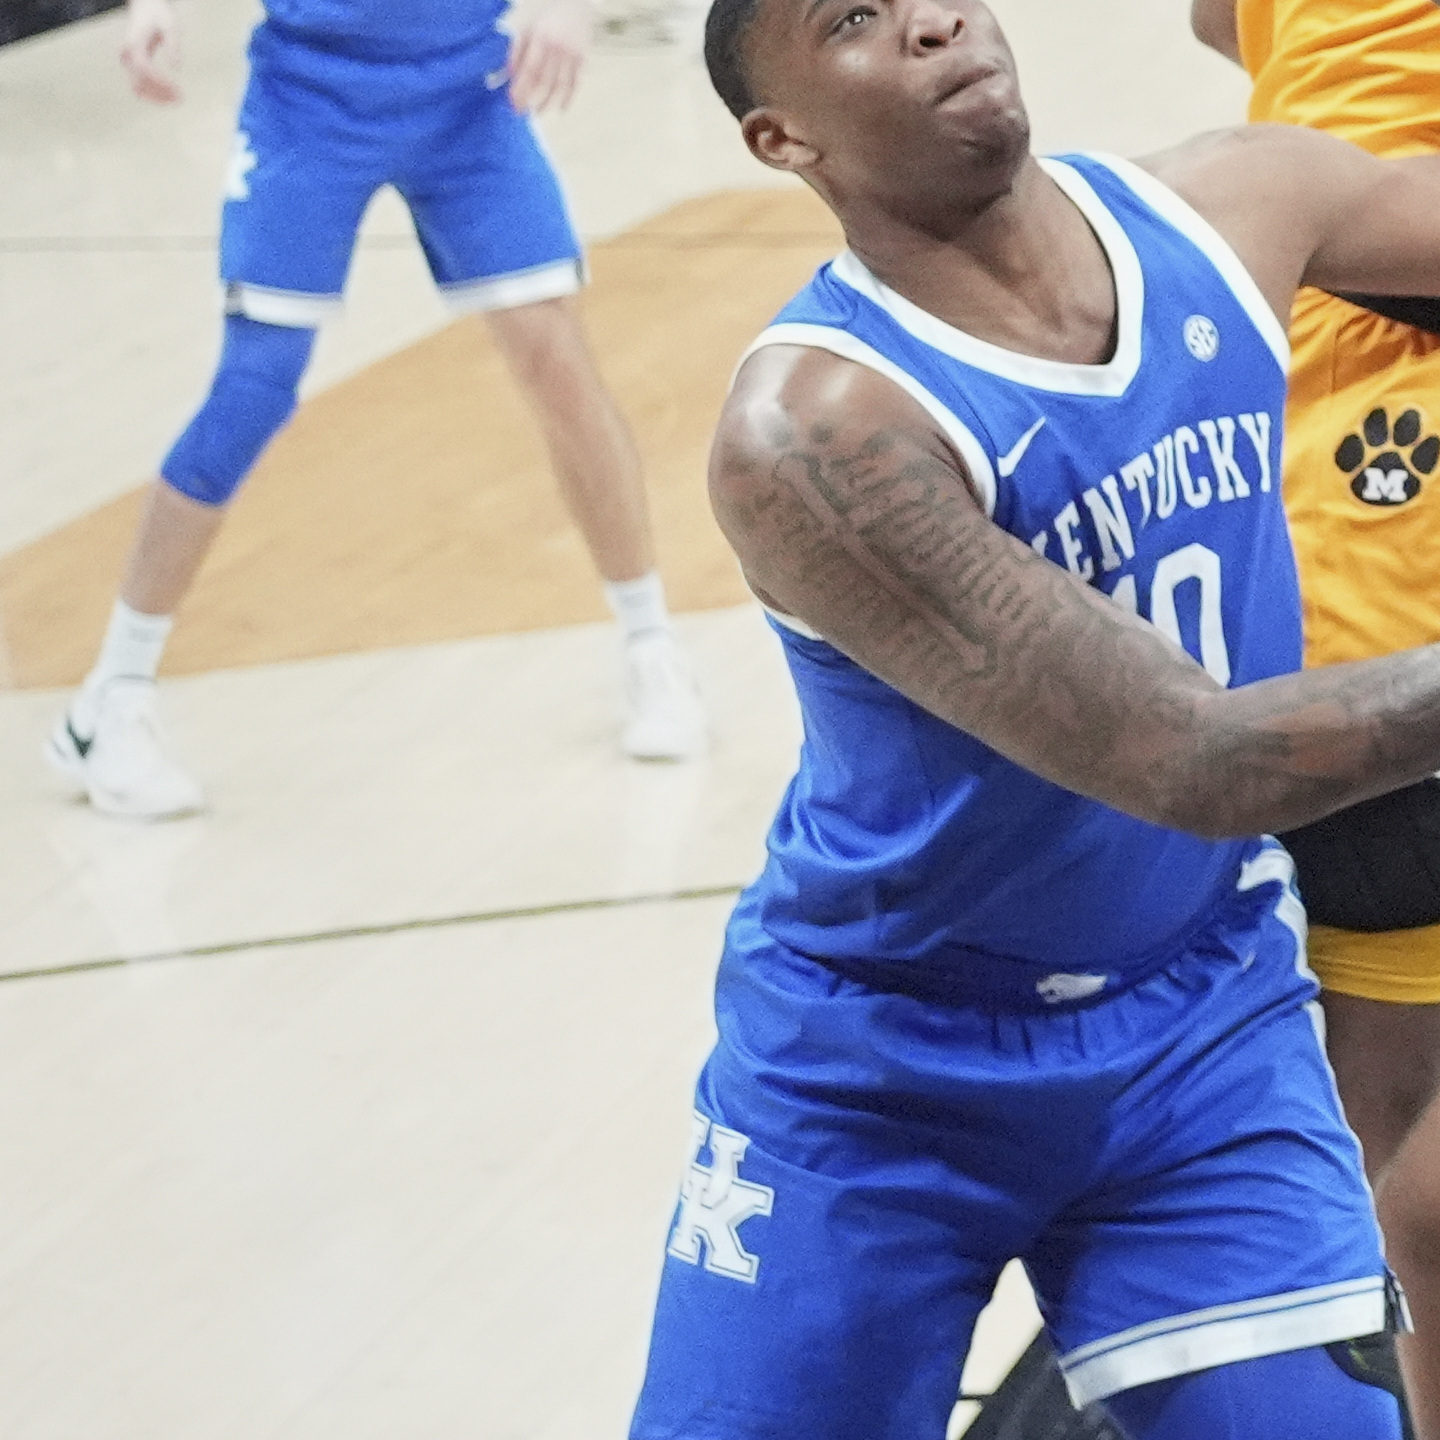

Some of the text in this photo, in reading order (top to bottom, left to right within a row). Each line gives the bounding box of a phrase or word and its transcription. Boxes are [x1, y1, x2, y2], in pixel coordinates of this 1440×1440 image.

[1031, 412, 1271, 583] ENTUCKY
[1362, 467, 1409, 503] M
[1112, 542, 1231, 689] 0
